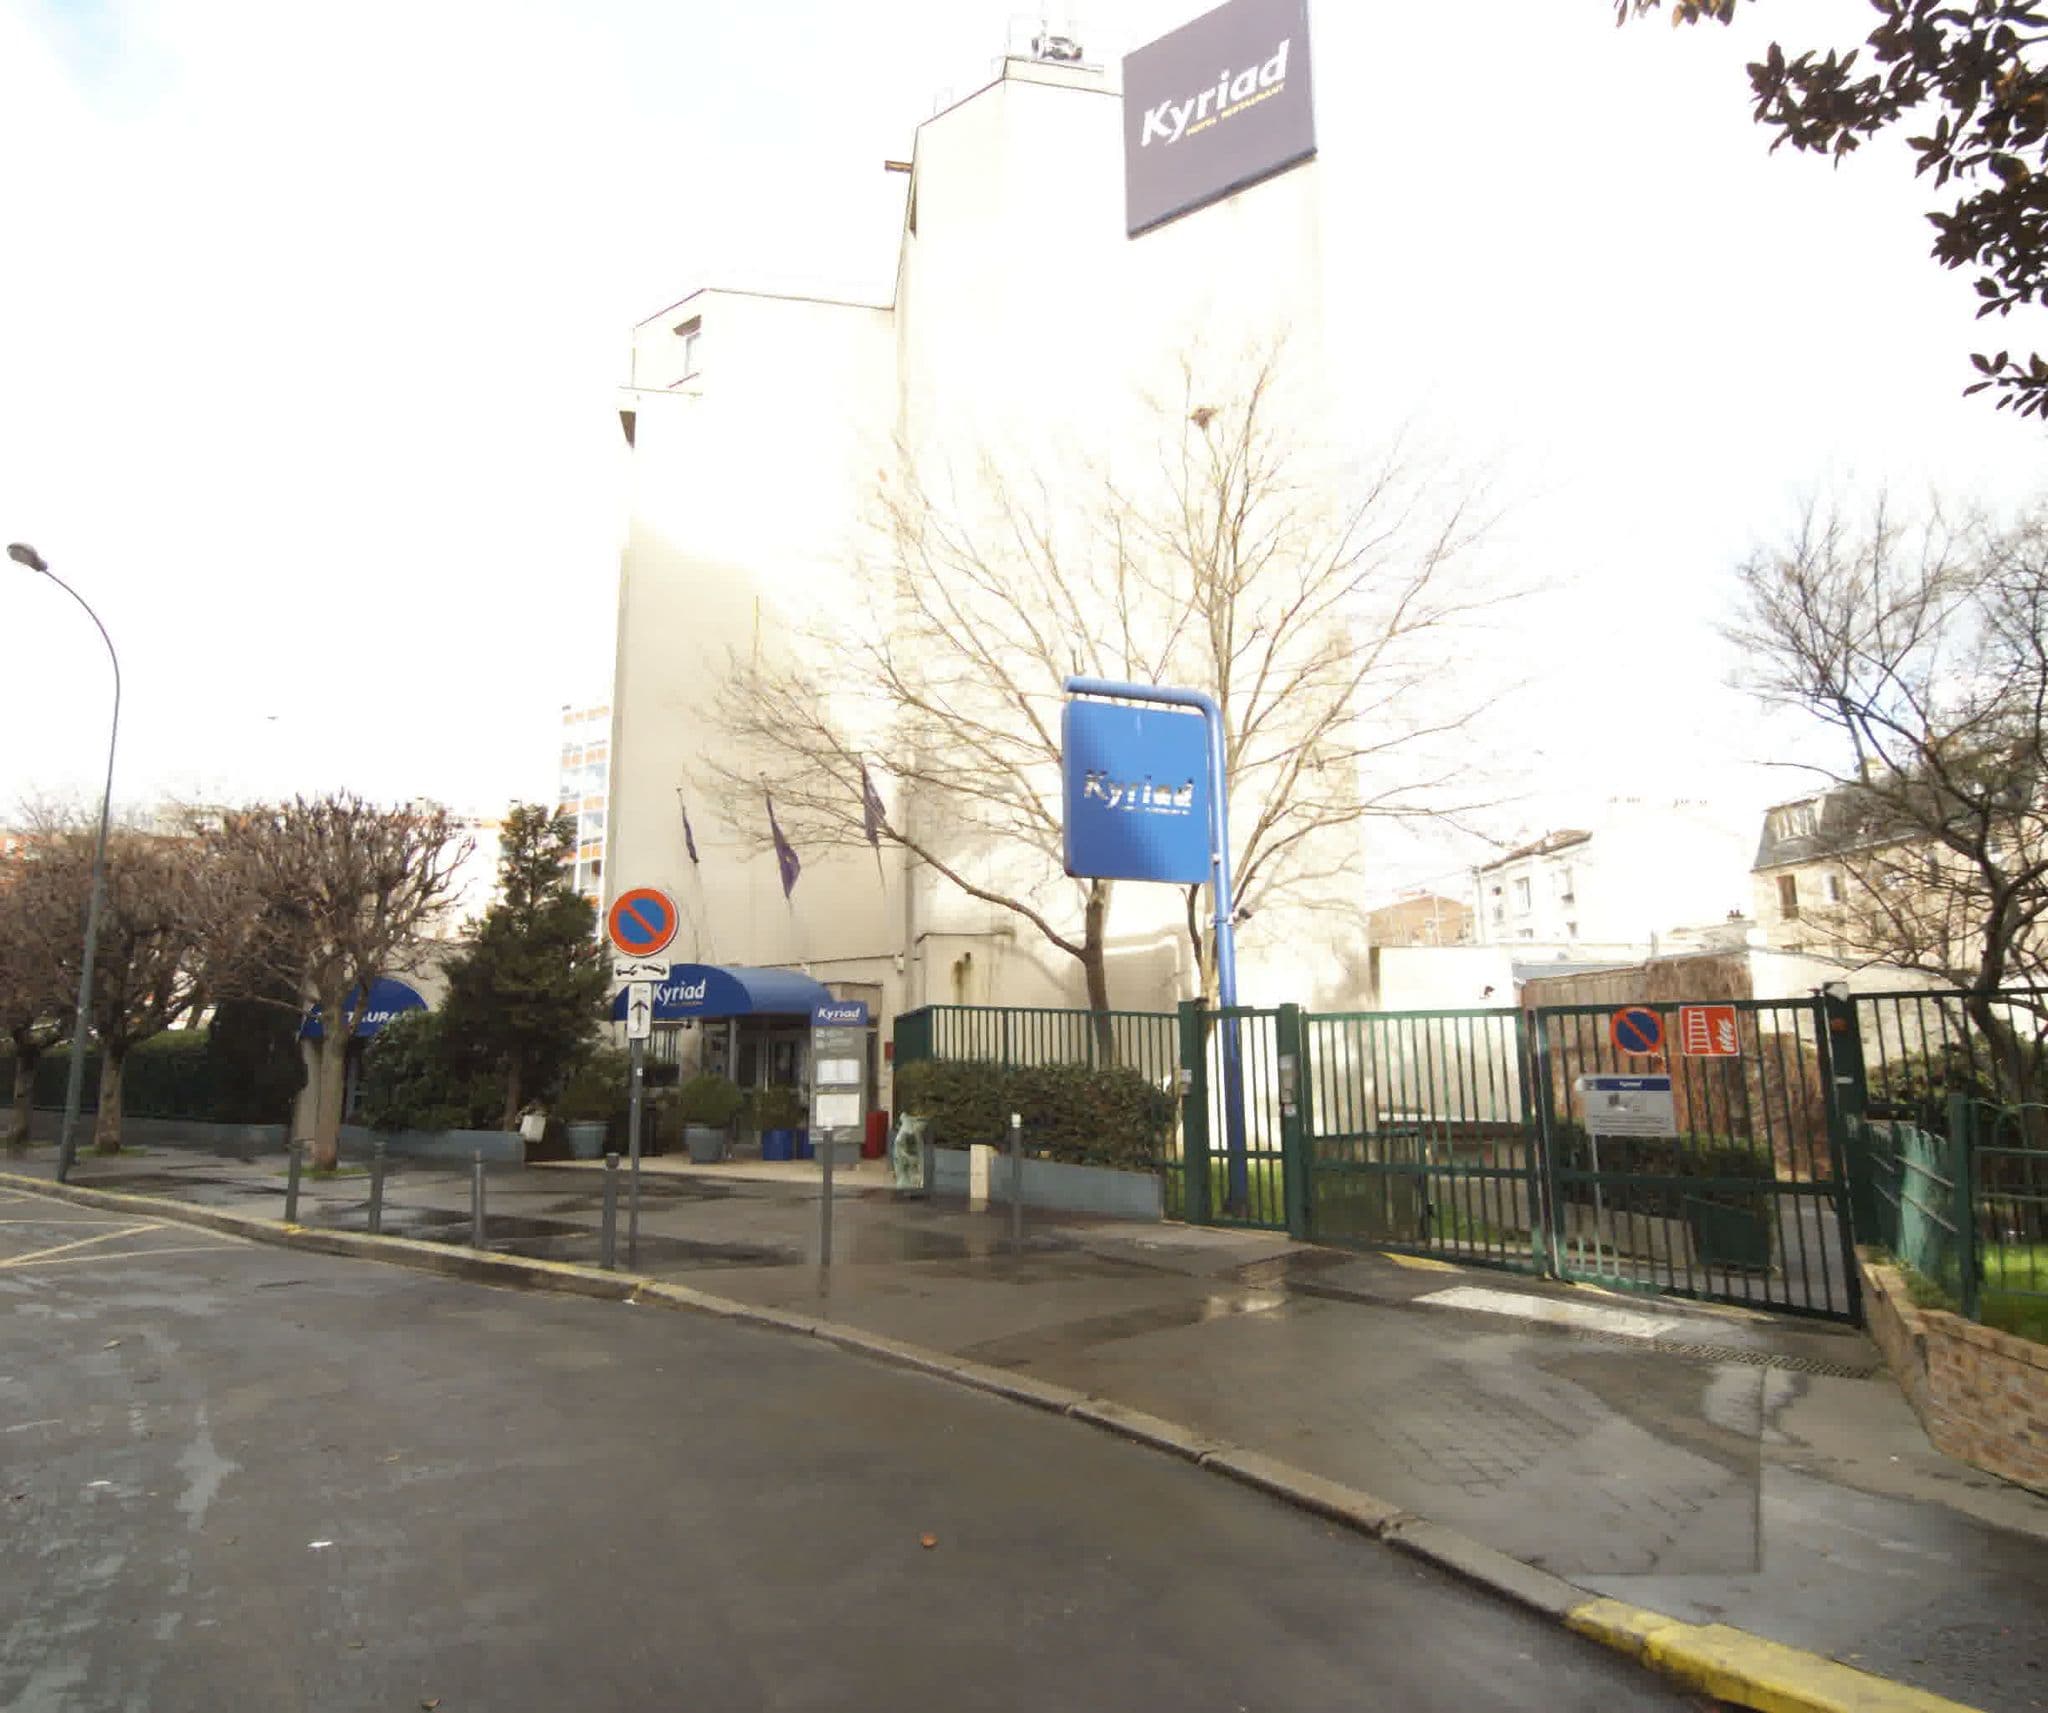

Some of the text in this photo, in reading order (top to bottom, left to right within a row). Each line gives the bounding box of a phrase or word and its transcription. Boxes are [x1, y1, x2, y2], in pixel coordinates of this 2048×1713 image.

[1140, 38, 1290, 147] Kyriad
[1084, 769, 1194, 810] Kyriad
[653, 977, 706, 1006] Kyriad
[817, 1006, 861, 1020] Kyriad
